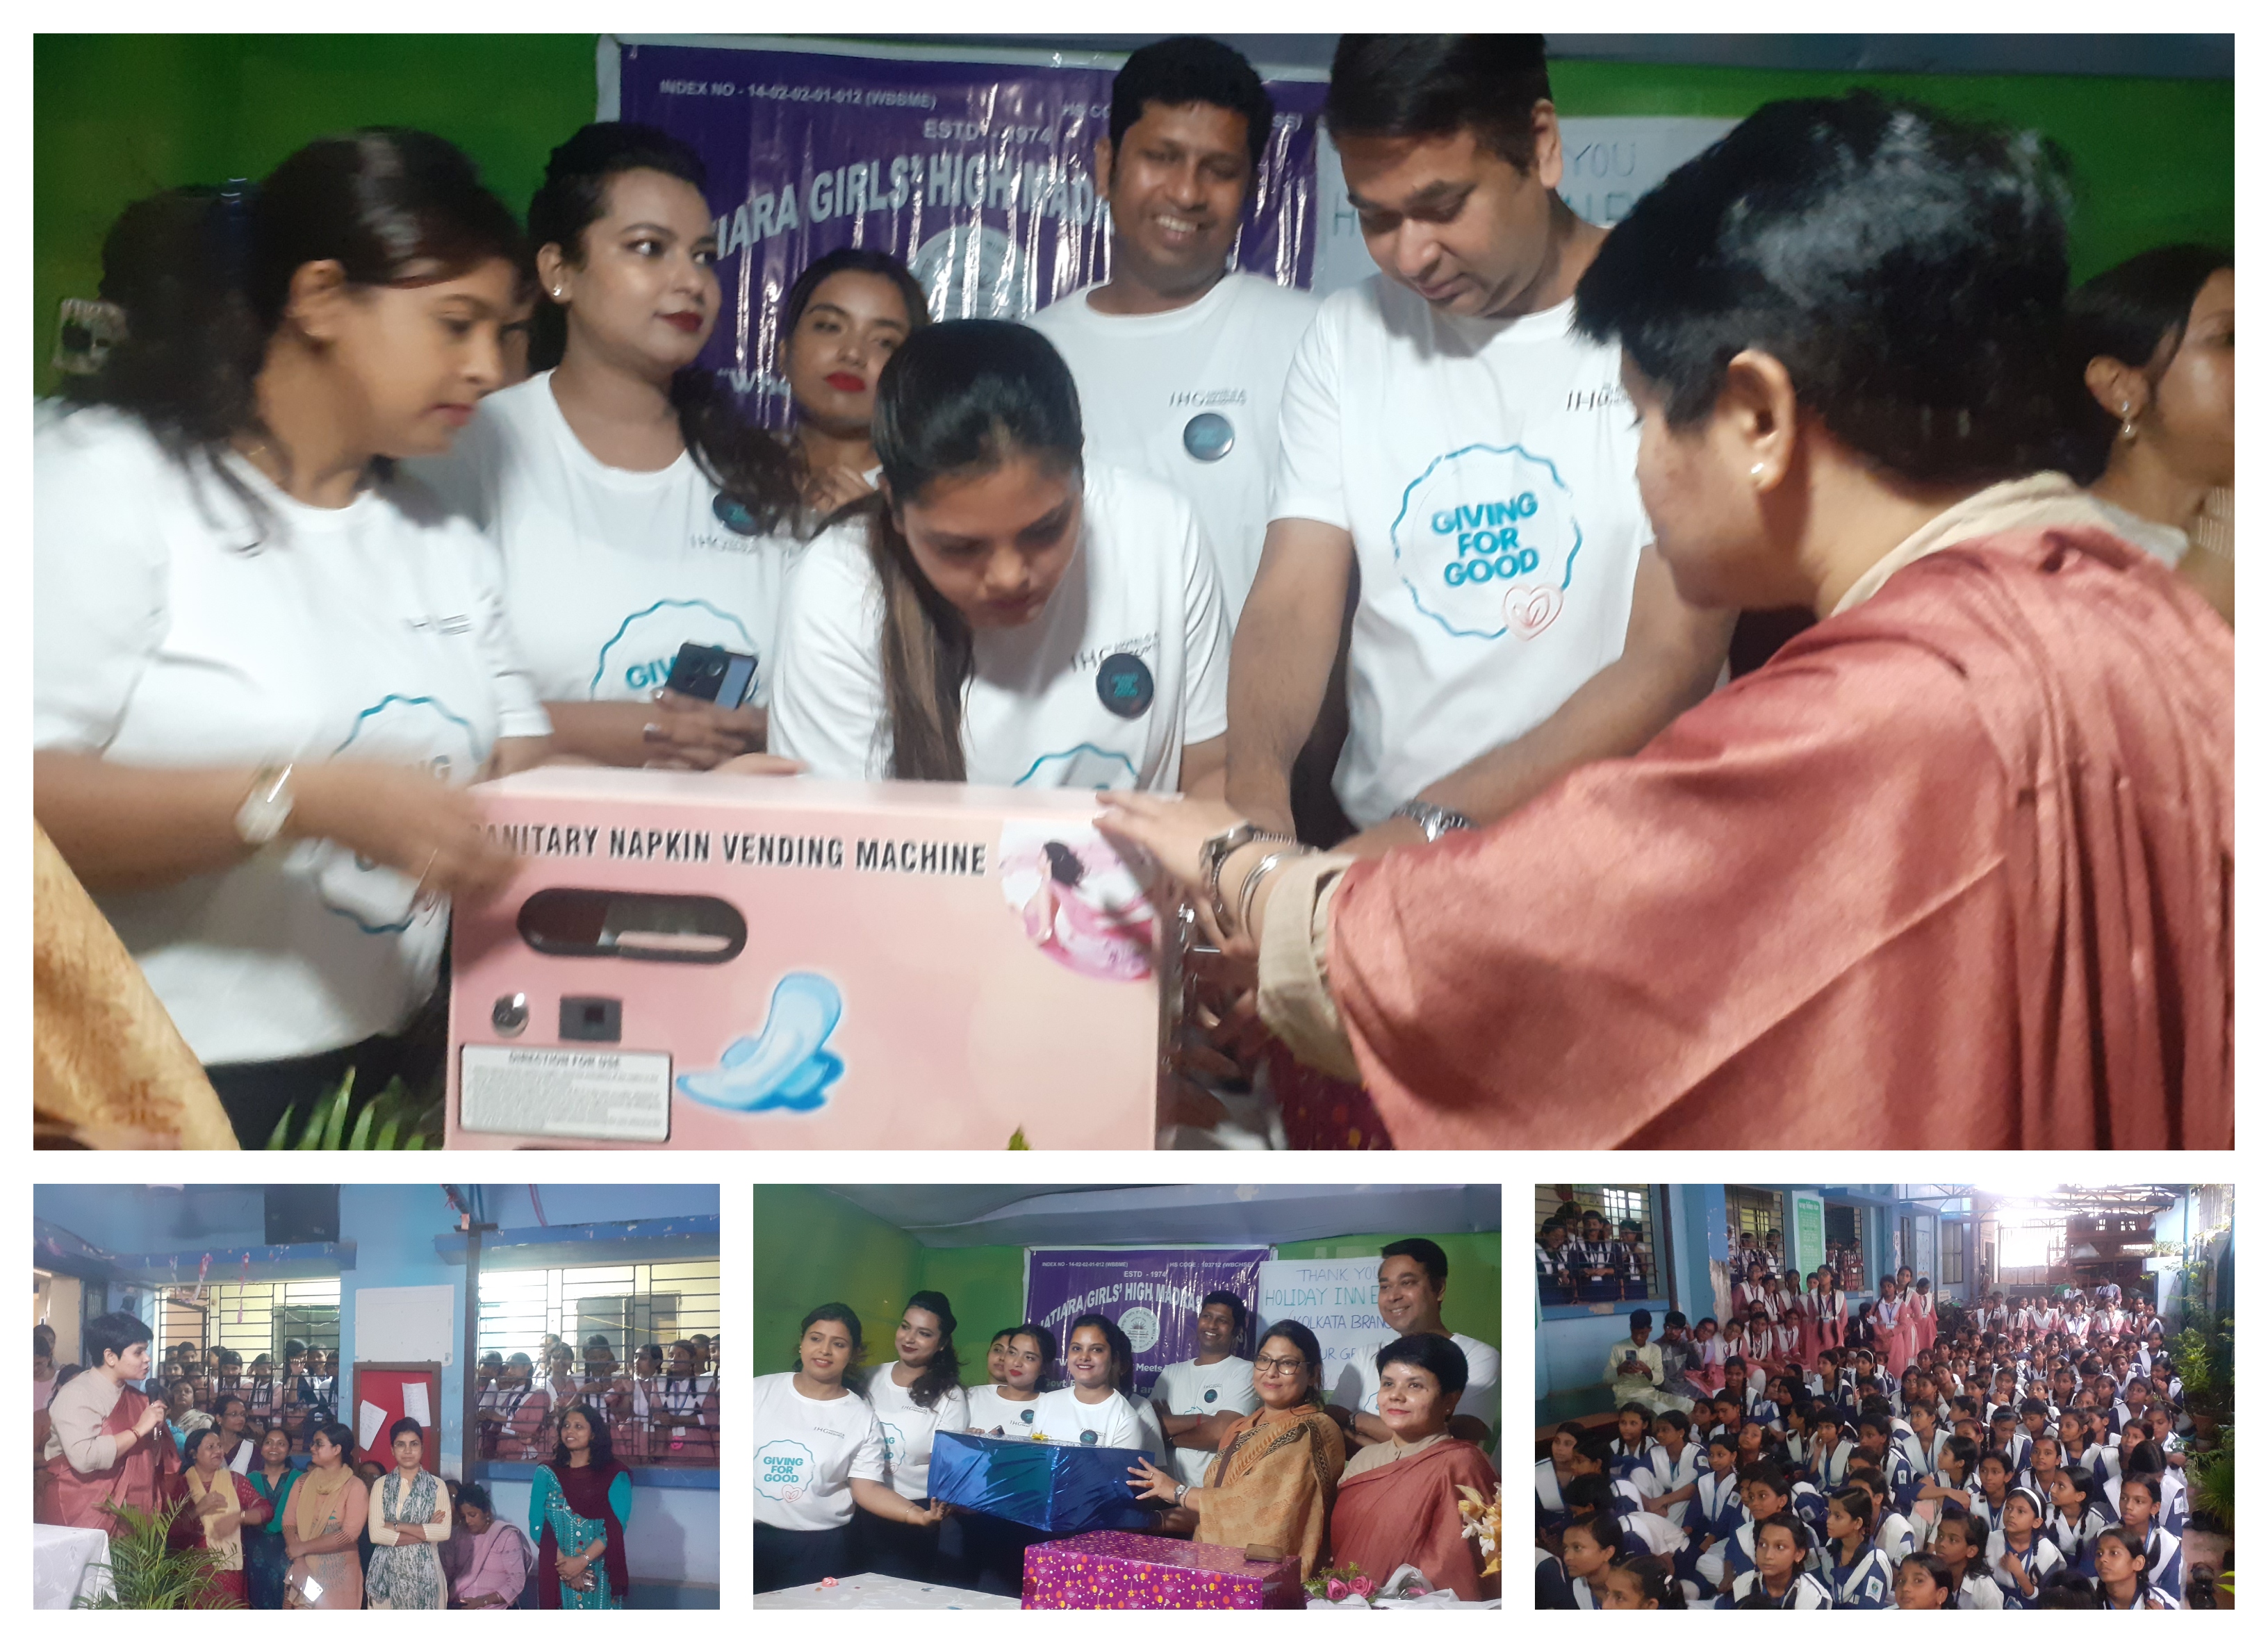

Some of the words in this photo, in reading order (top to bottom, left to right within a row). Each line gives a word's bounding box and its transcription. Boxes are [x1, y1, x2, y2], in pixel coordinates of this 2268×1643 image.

[659, 79, 707, 96] INDEX
[711, 80, 735, 97] NO
[923, 118, 980, 139] ESTD
[716, 184, 799, 261] IARA
[928, 151, 1013, 208] HIGH
[1431, 490, 1538, 535] GIVING
[1458, 527, 1520, 559] FOR
[1444, 548, 1540, 587] GOOD
[470, 823, 600, 857] ANITARY
[609, 827, 712, 863] NAPKIN
[722, 832, 844, 869] VENDING
[855, 837, 987, 877] MACHINE
[1296, 1268, 1349, 1282] THANK
[1125, 1282, 1153, 1301] HIGH
[1156, 1283, 1202, 1314] MADRAS
[1265, 1287, 1328, 1306] HOLIDAY
[1334, 1286, 1365, 1305] INN
[763, 1456, 803, 1466] GIVING
[771, 1465, 794, 1473] FOR
[764, 1473, 799, 1483] GOOD
